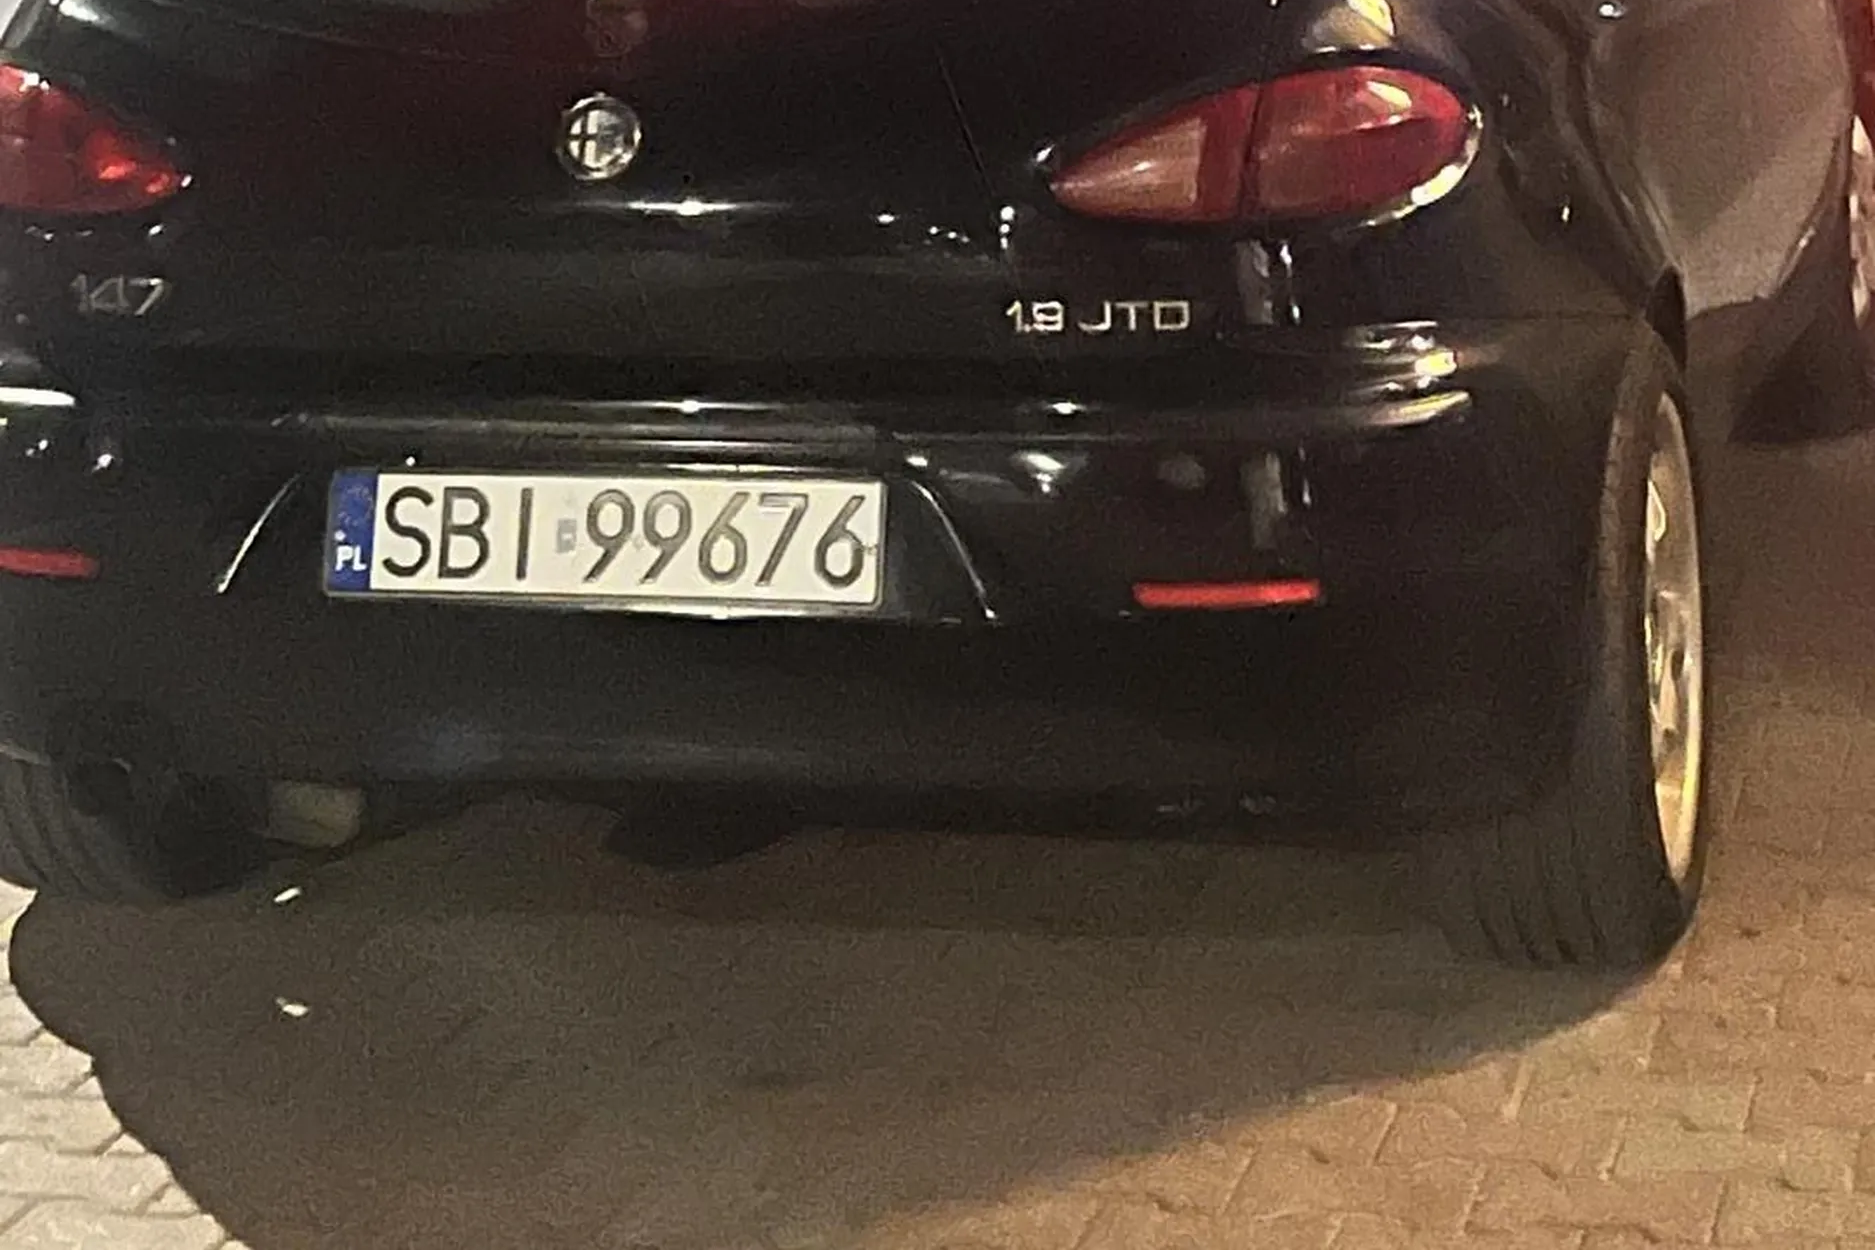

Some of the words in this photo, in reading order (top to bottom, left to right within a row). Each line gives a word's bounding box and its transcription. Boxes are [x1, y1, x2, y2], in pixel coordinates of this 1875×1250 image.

[69, 273, 165, 317] 147
[1077, 300, 1190, 332] JTD
[380, 485, 534, 581] SBI
[581, 488, 867, 588] 99676
[335, 544, 367, 571] PL
